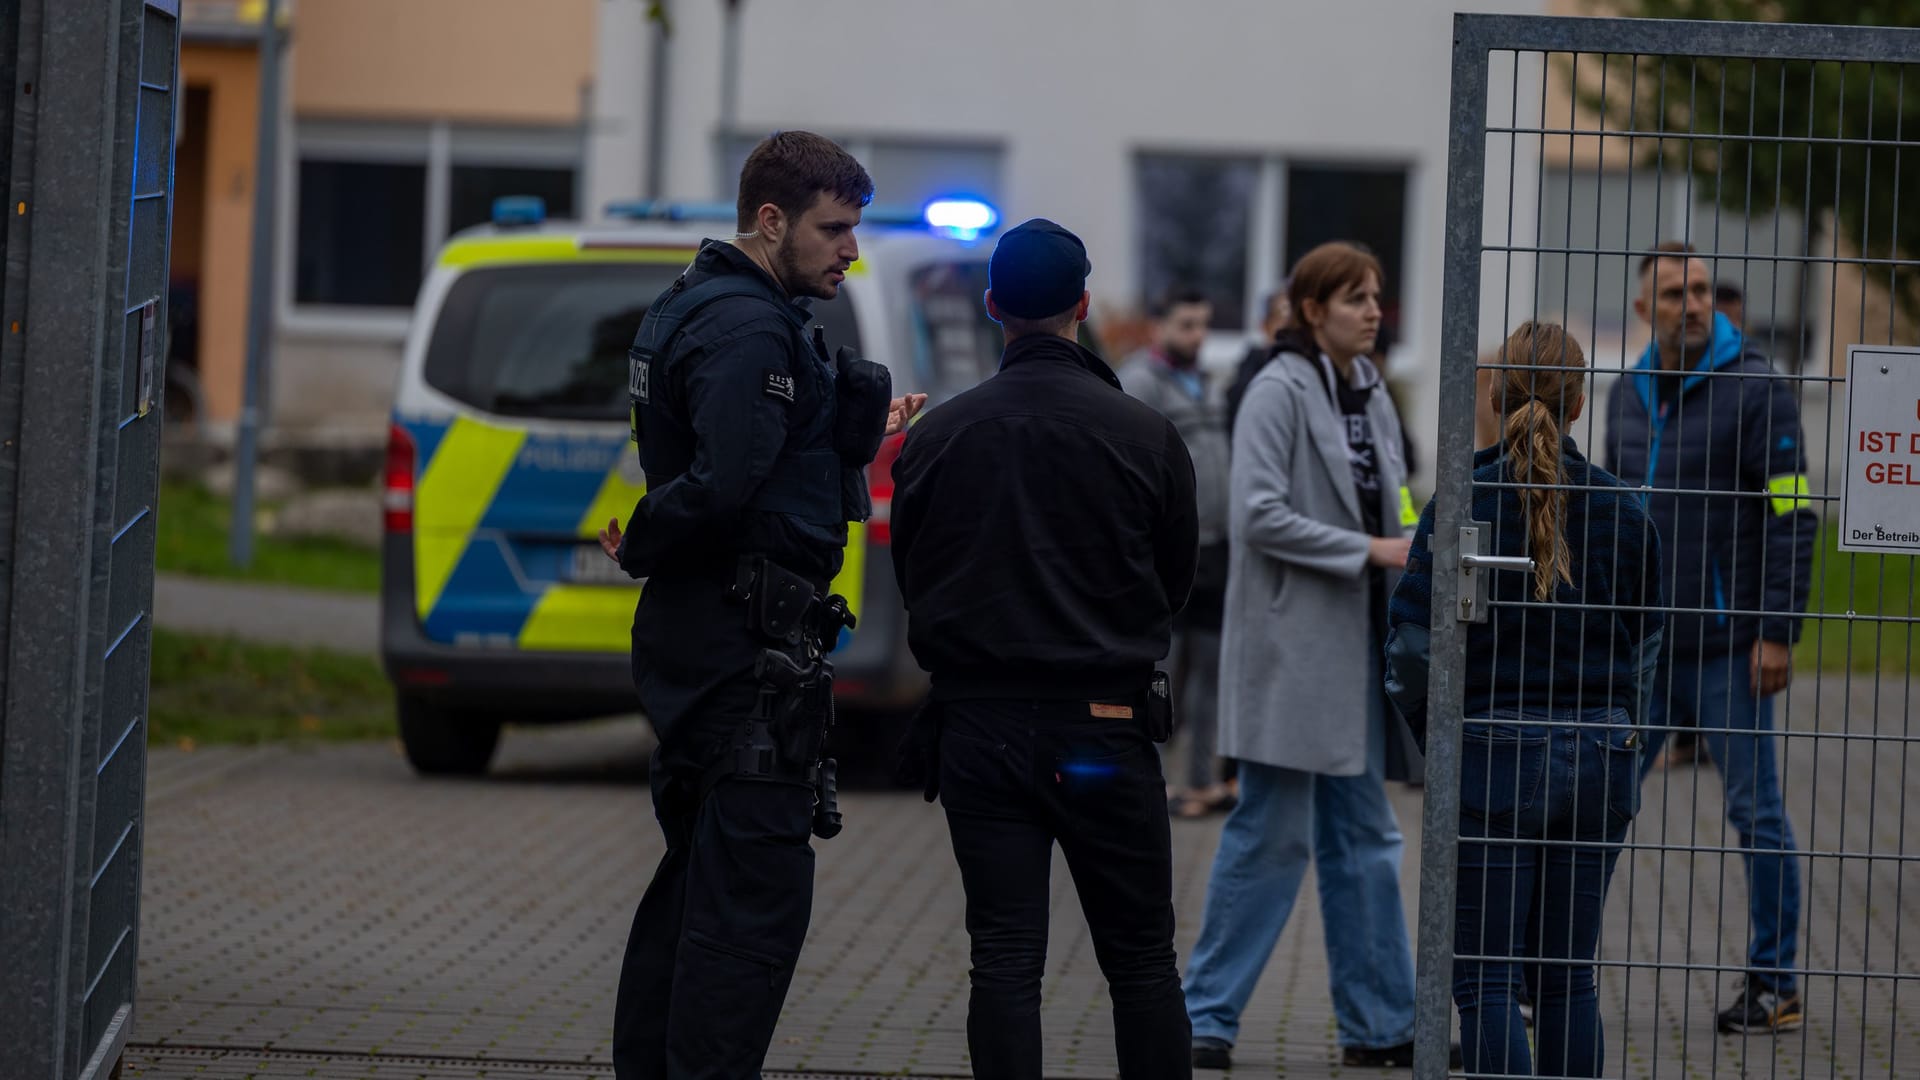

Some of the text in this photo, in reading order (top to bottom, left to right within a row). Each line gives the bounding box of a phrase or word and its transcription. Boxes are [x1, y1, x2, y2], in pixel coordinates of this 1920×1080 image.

[629, 356, 649, 399] LIZEI
[1859, 431, 1901, 453] IST
[1865, 462, 1920, 485] GEL
[1852, 529, 1874, 541] Der
